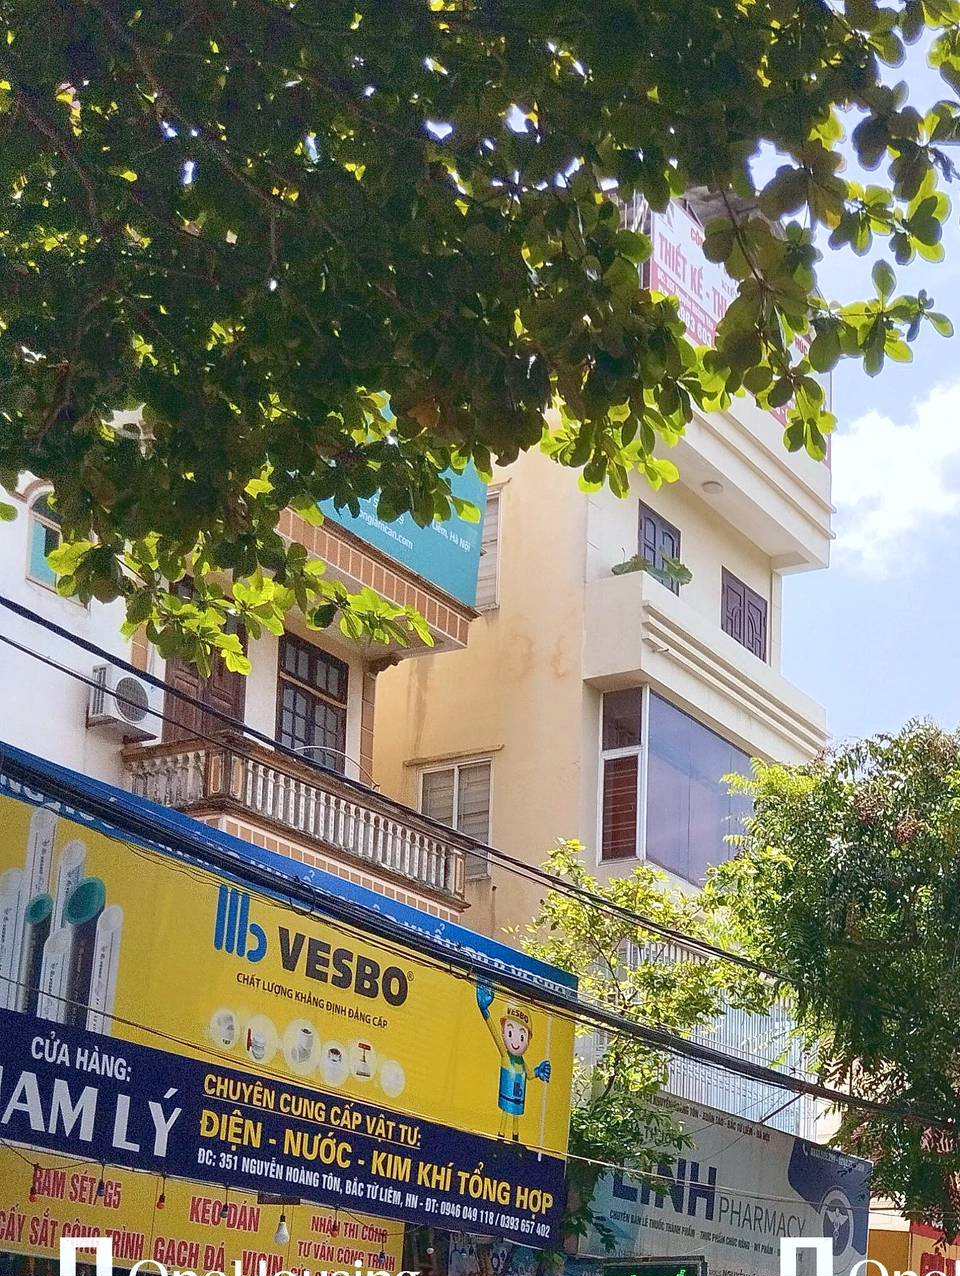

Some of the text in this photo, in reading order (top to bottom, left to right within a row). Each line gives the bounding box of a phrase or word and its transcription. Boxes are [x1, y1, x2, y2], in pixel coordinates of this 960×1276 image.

[659, 232, 687, 283] THIẾT
[691, 264, 703, 300] KẾ
[278, 925, 408, 1006] VESBO
[237, 972, 260, 987] CHẤT
[262, 980, 293, 998] LƯỢNG
[325, 1000, 346, 1017] ĐỊNH
[372, 1013, 388, 1028] CẤP
[507, 1007, 528, 1023] VESBO
[32, 1031, 131, 1082] CỬA HÀNG:
[0, 1065, 182, 1158] AM LÝ
[204, 1073, 421, 1147] CHUYÊN CUNG CẤP VẬT TƯ:
[200, 1108, 262, 1151] ĐIỆN
[283, 1129, 352, 1169] NƯỚC
[371, 1150, 411, 1182] KIM
[417, 1161, 453, 1191] KHÍ
[457, 1161, 510, 1206] TỔNG
[516, 1185, 553, 1219] HỢP
[197, 1147, 216, 1166] ĐC:
[219, 1152, 237, 1171] 351
[241, 1157, 284, 1180] NGUYỄN
[285, 1164, 319, 1187] HOÀNG
[322, 1172, 343, 1195] TÔN,
[345, 1177, 364, 1197] BẮC
[366, 1182, 379, 1200] TỪ
[379, 1187, 403, 1208] LIÊM,
[405, 1193, 419, 1209] HN
[440, 1201, 460, 1219] 0946
[462, 1205, 478, 1221] 049
[480, 1209, 494, 1225] 118
[520, 1219, 535, 1234] 657
[536, 1222, 550, 1238] 402
[226, 1201, 260, 1232] DÁN
[718, 1196, 806, 1238] PHARMACY
[29, 1208, 58, 1248] SẮT
[343, 1222, 358, 1240] THI
[361, 1224, 388, 1243] CÔNG
[153, 1237, 199, 1271] GẠCH
[203, 1242, 225, 1273] ĐÁ
[298, 1241, 312, 1257] TƯ
[313, 1240, 334, 1262] VẤN
[367, 1252, 396, 1271] TRNH
